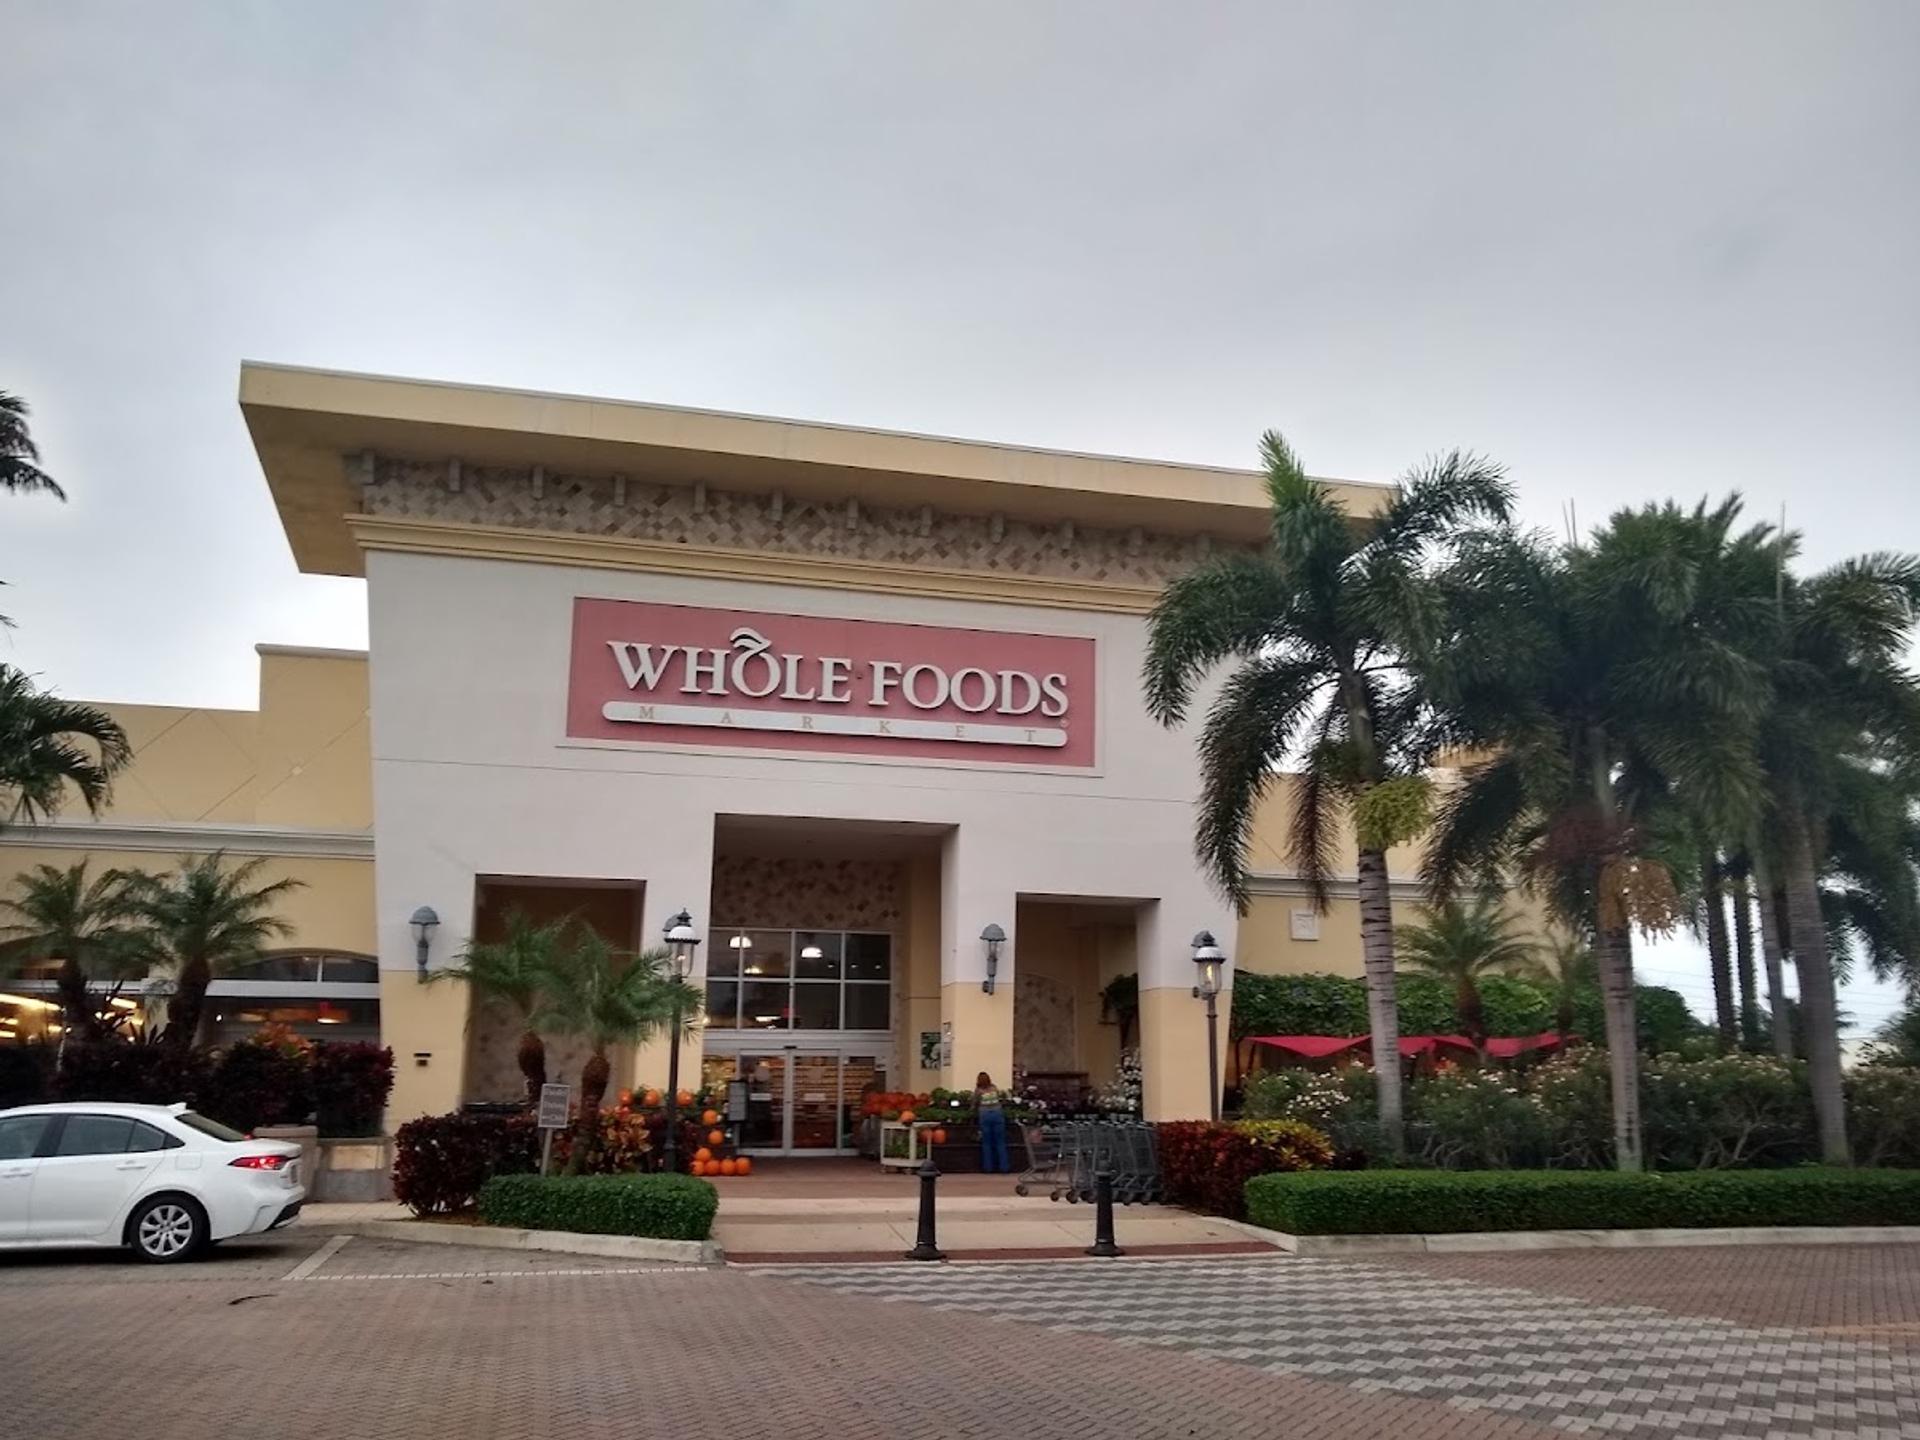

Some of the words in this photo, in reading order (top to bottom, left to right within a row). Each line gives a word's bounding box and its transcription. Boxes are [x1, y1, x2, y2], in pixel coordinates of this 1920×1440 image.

[606, 627, 852, 703] WHOLE
[868, 661, 1069, 717] FOODS
[639, 705, 1036, 742] MARKET
